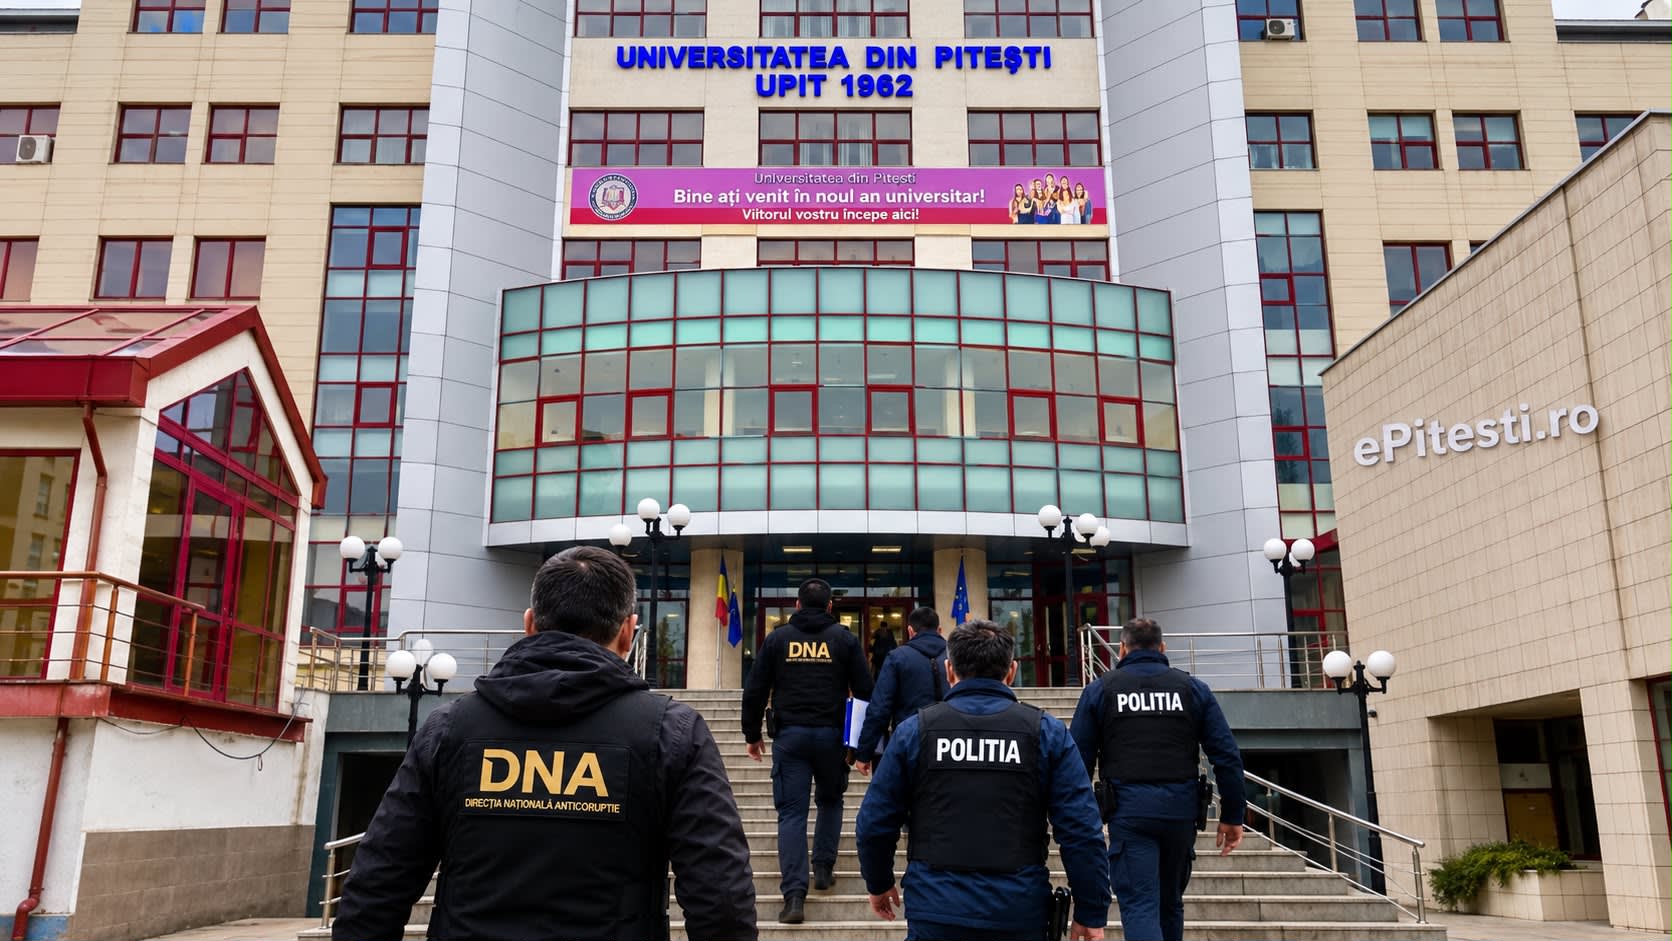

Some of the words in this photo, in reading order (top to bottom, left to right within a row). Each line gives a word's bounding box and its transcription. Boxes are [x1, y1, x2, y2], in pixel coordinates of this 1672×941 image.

[616, 45, 850, 69] UNIVERSITATEA
[865, 45, 917, 69] DIN
[755, 73, 827, 98] UPIT
[841, 73, 914, 98] 1962
[754, 172, 844, 185] Universitatea
[847, 172, 869, 185] din
[673, 188, 713, 204] Bine
[717, 188, 741, 207] ați
[745, 188, 790, 204] venit
[794, 188, 810, 204] în
[815, 187, 854, 204] noul
[859, 191, 881, 204] an
[885, 187, 985, 204] universitar!
[742, 208, 792, 221] Viitorul
[795, 208, 839, 221] vostru
[842, 208, 889, 223] începe
[891, 207, 920, 221] aici!
[1353, 402, 1601, 466] ePitesti.ro
[788, 641, 831, 659] DNA
[1117, 692, 1184, 713] POLITIA
[936, 738, 1022, 764] POLITIA
[479, 748, 609, 798] DNA
